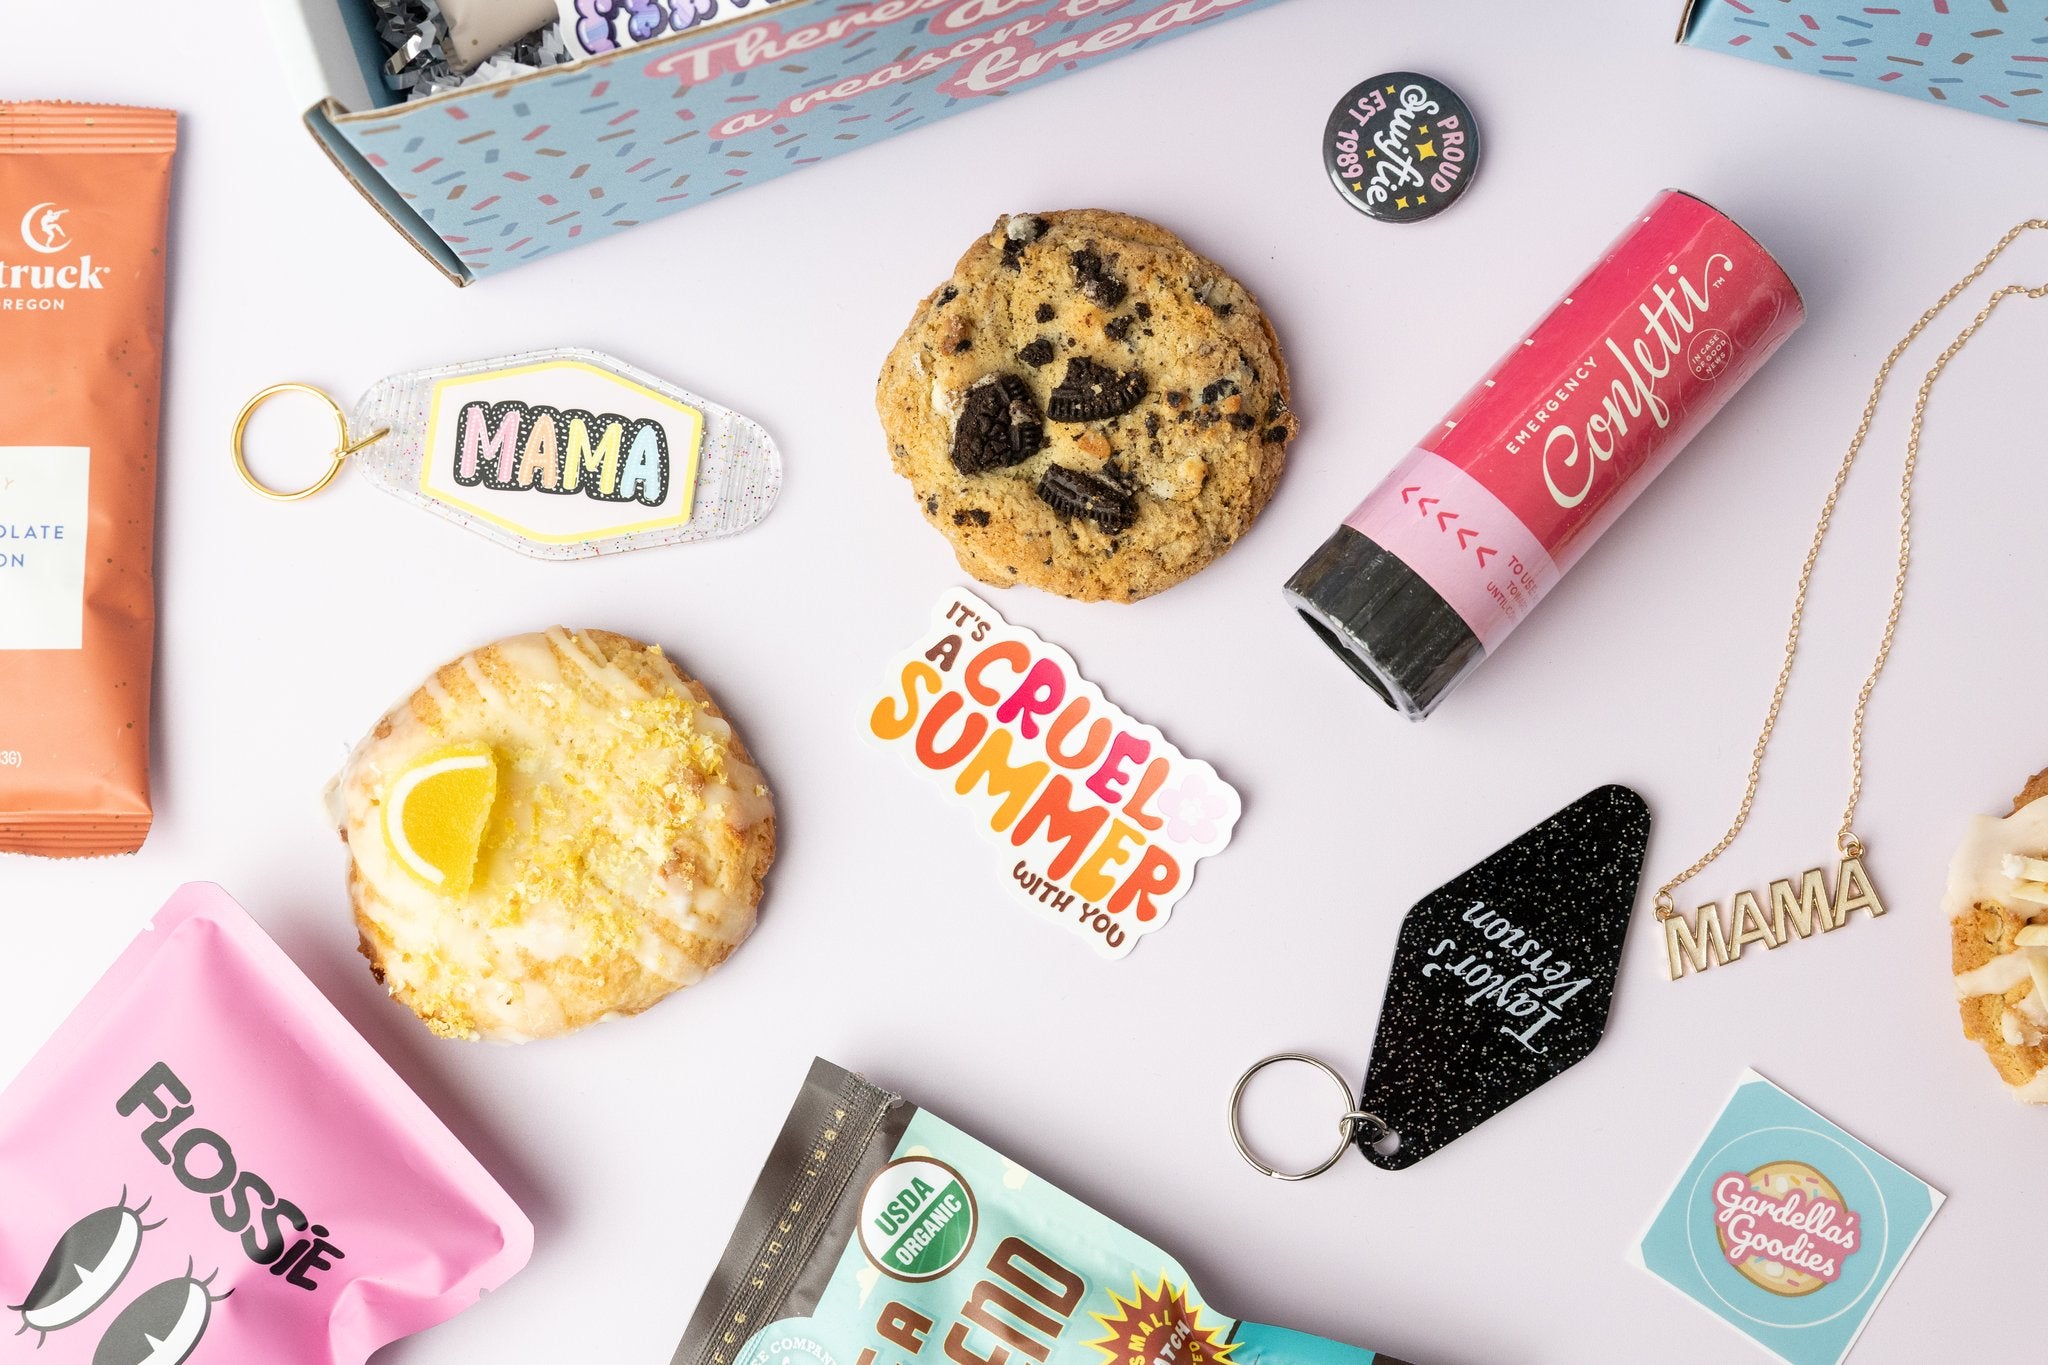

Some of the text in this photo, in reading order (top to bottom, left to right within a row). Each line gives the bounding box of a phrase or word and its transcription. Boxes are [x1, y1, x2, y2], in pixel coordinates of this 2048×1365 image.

[657, 0, 942, 80] There
[790, 20, 1046, 112] reason
[953, 0, 1252, 91] trea
[1336, 89, 1387, 179] EST 1989
[1366, 84, 1439, 205] Swiftie
[1437, 115, 1465, 193] PROUD
[1542, 253, 1733, 508] Confetti
[1692, 334, 1719, 364] IN CASE
[1695, 339, 1726, 373] OF GOOD
[1706, 352, 1726, 374] NEWS
[1505, 356, 1599, 455] EMERGENCY
[459, 404, 662, 501] MAMA
[1487, 581, 1508, 610] UNTIL
[1508, 555, 1524, 575] TO
[946, 601, 991, 642] IT'S
[925, 634, 1170, 831] A CRUEL
[870, 660, 1181, 922] SUMMER
[1013, 860, 1125, 948] WITH YOU
[1664, 857, 1887, 981] MAMA
[1462, 901, 1592, 1010] Version
[1422, 939, 1562, 1054] Taylor's
[807, 1108, 845, 1177] 1984
[874, 1176, 935, 1236] USDA
[895, 1194, 962, 1266] ORGANIC
[1716, 1177, 1854, 1249] Gardella's
[1727, 1214, 1834, 1277] Goodies
[770, 1337, 838, 1365] COMPAN
[1128, 1310, 1171, 1365] SMALL
